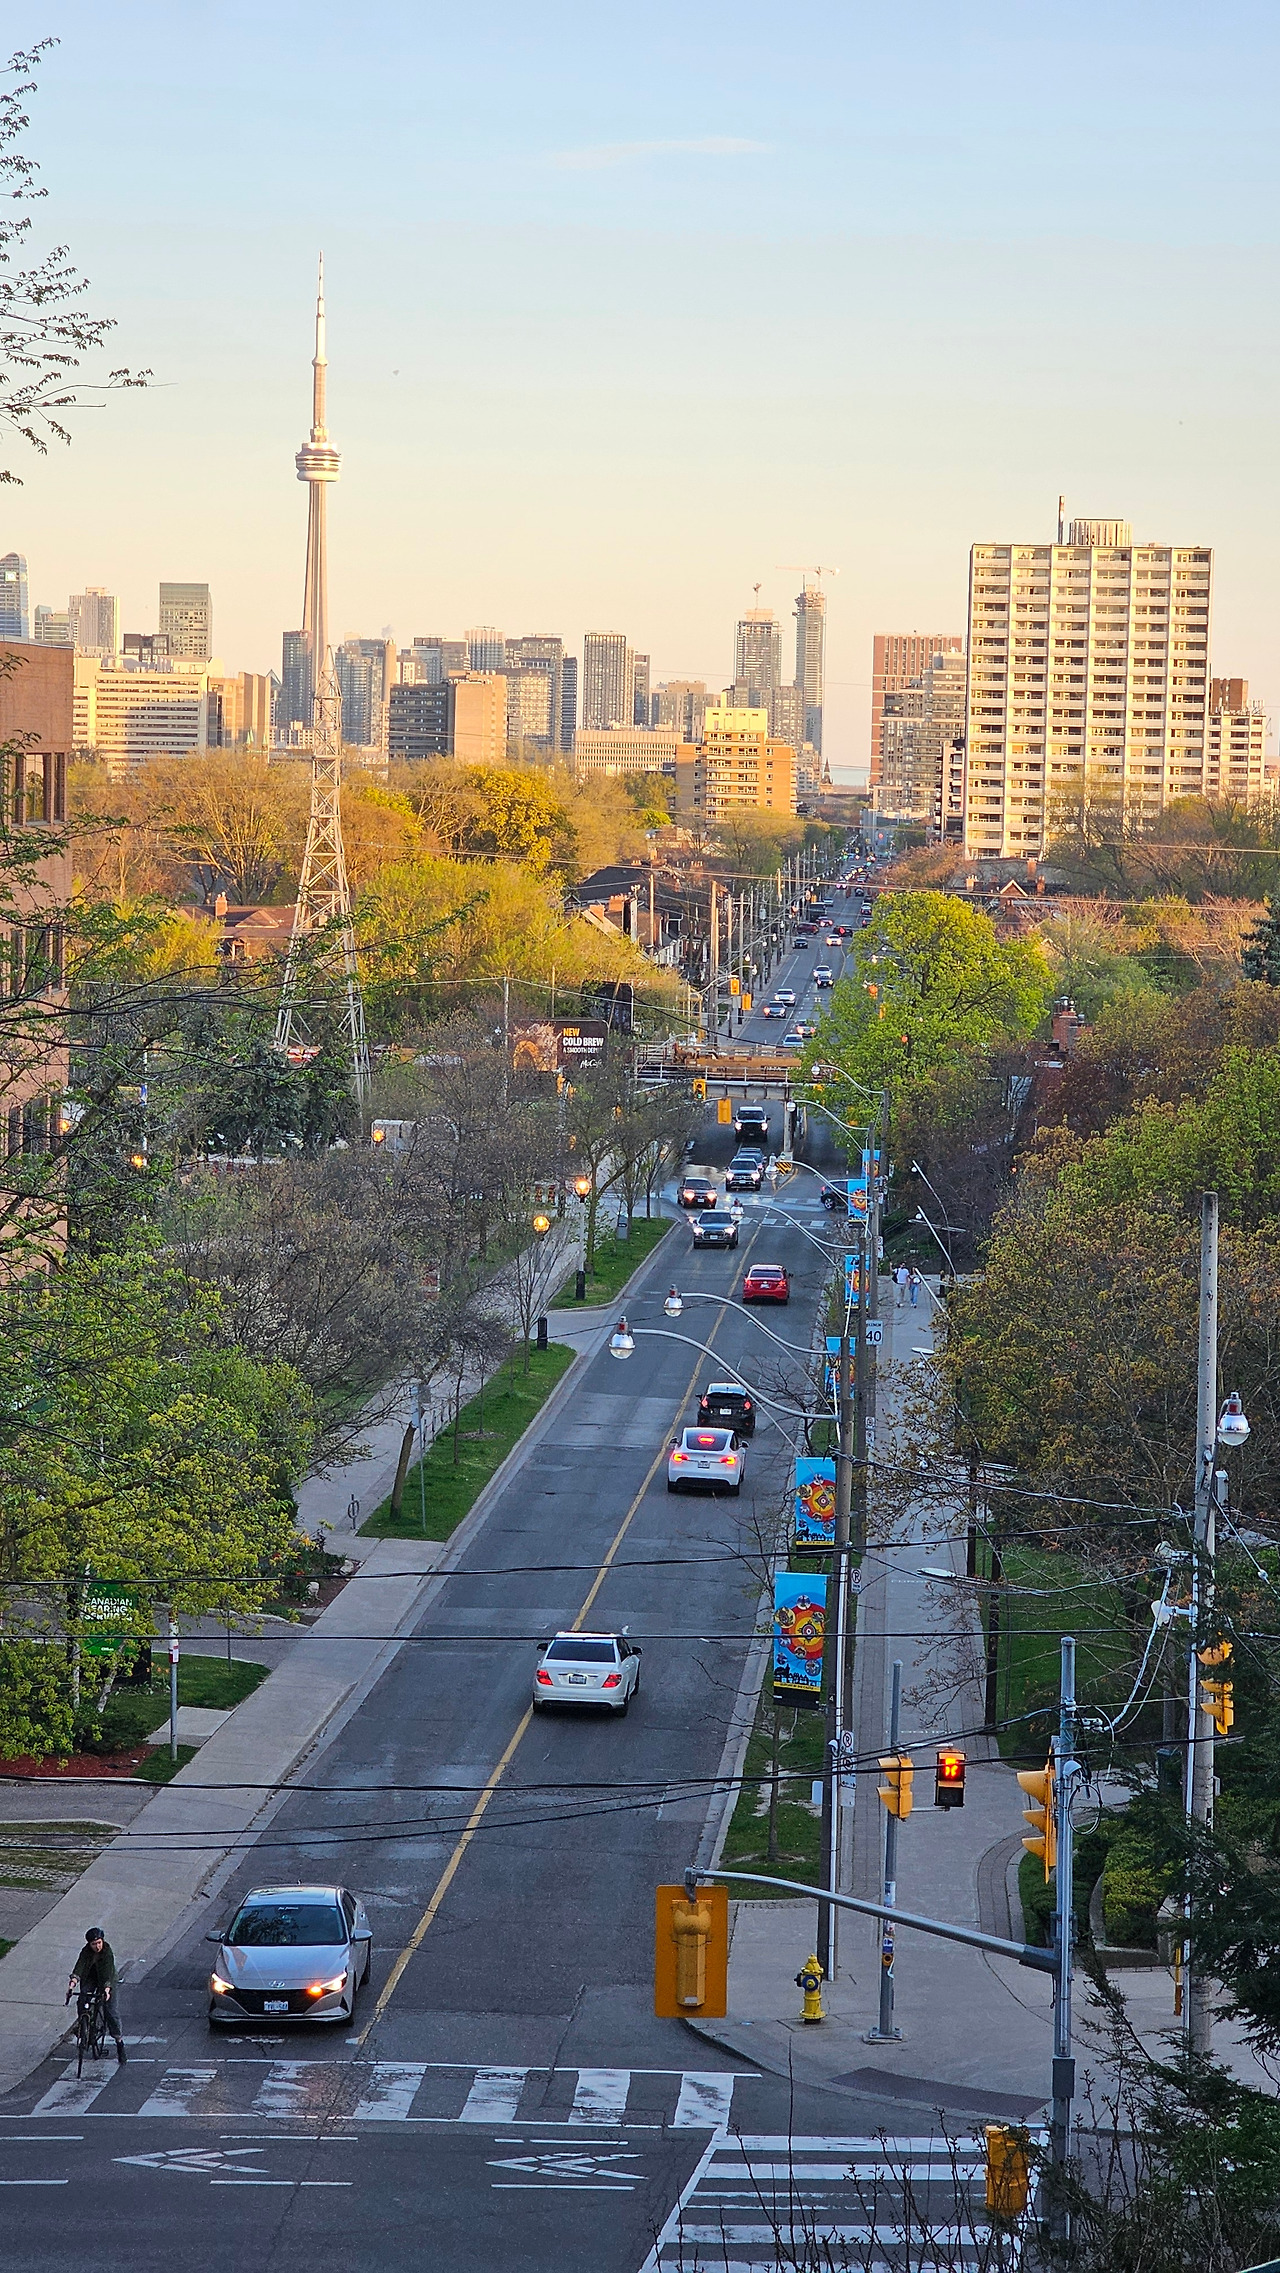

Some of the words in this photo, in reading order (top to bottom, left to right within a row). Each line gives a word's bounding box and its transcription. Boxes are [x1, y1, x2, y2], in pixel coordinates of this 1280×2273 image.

[563, 1027, 580, 1037] NEW
[562, 1037, 583, 1047] COLD
[583, 1037, 604, 1047] BREW
[567, 1046, 587, 1054] SMOOTH
[866, 1330, 882, 1342] 40
